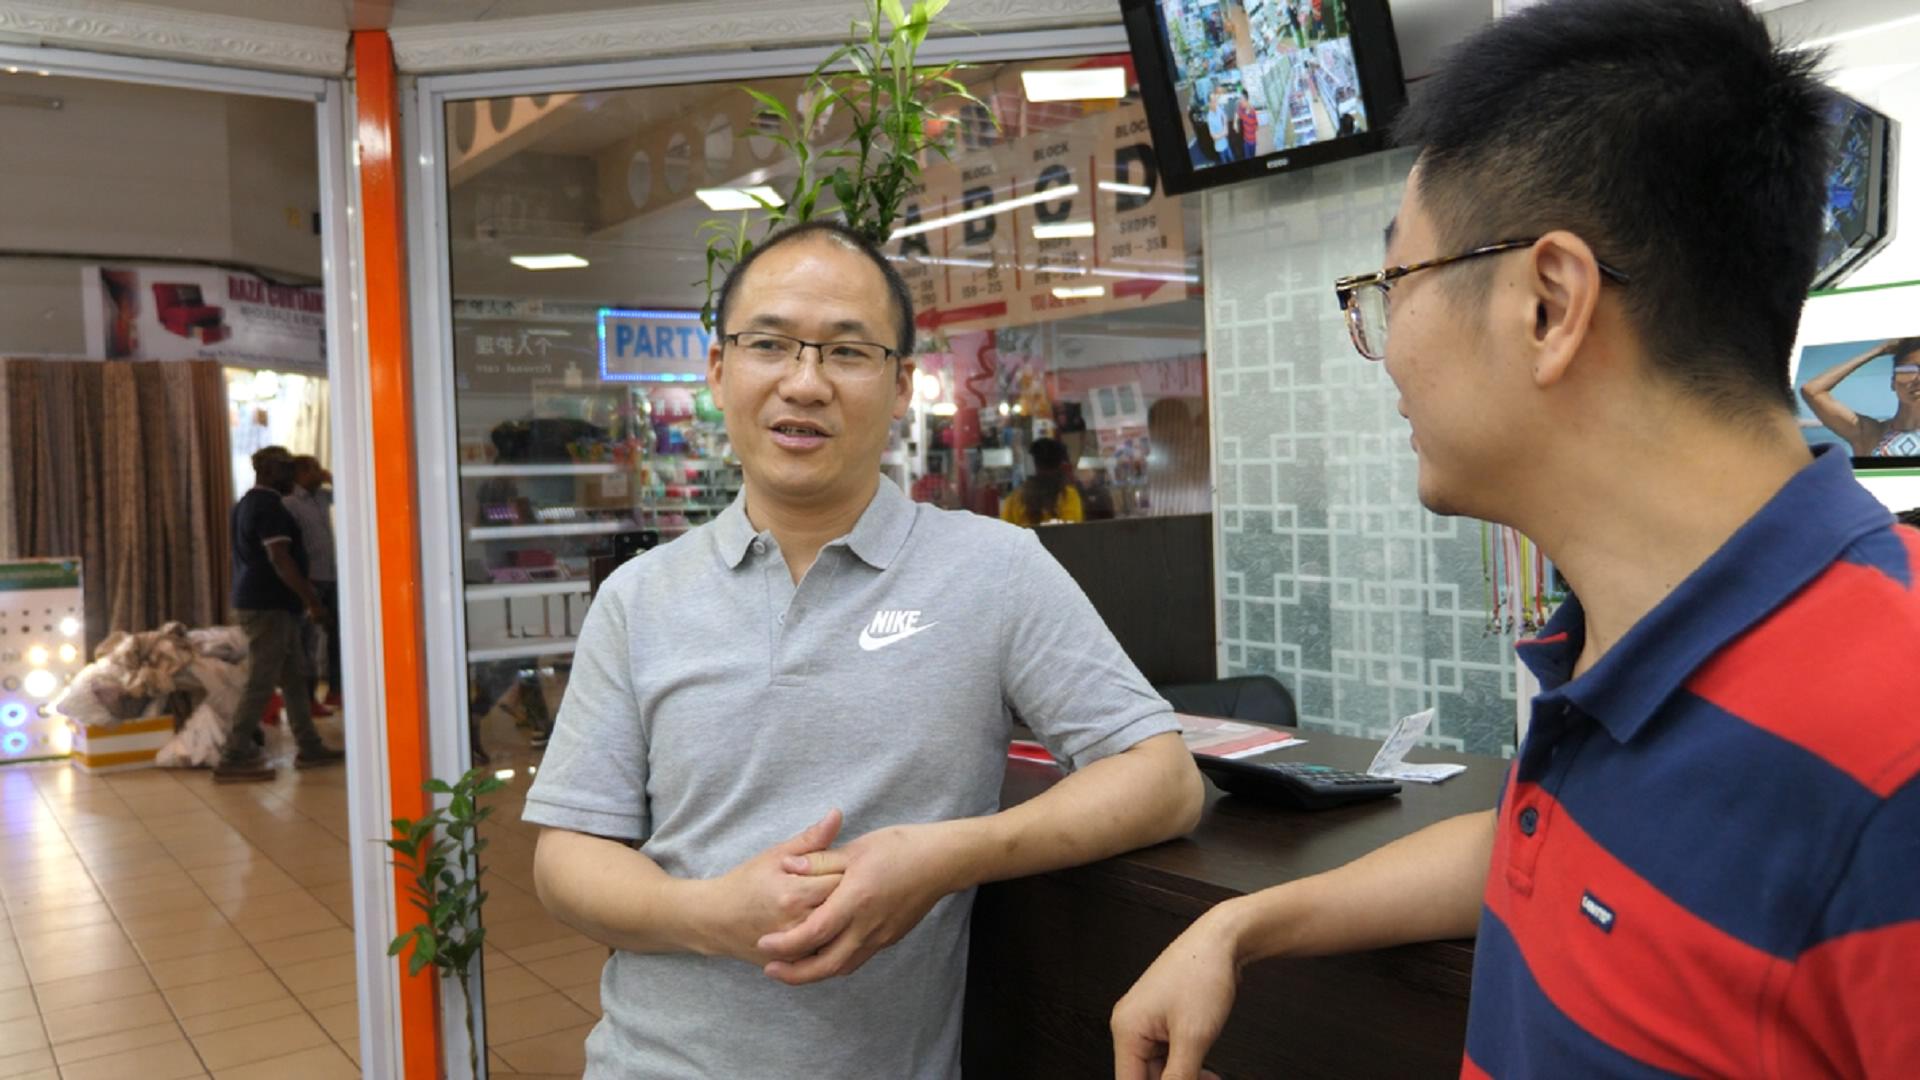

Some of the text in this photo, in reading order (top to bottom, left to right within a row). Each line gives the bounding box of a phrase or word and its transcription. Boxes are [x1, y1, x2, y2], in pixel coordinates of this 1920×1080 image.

[1116, 119, 1148, 138] BLOC
[1033, 142, 1069, 161] BLOCK
[1115, 143, 1157, 213] D
[899, 204, 930, 256] A
[963, 185, 997, 246] B
[615, 323, 709, 358] PARTY
[869, 610, 921, 634] NIKE
